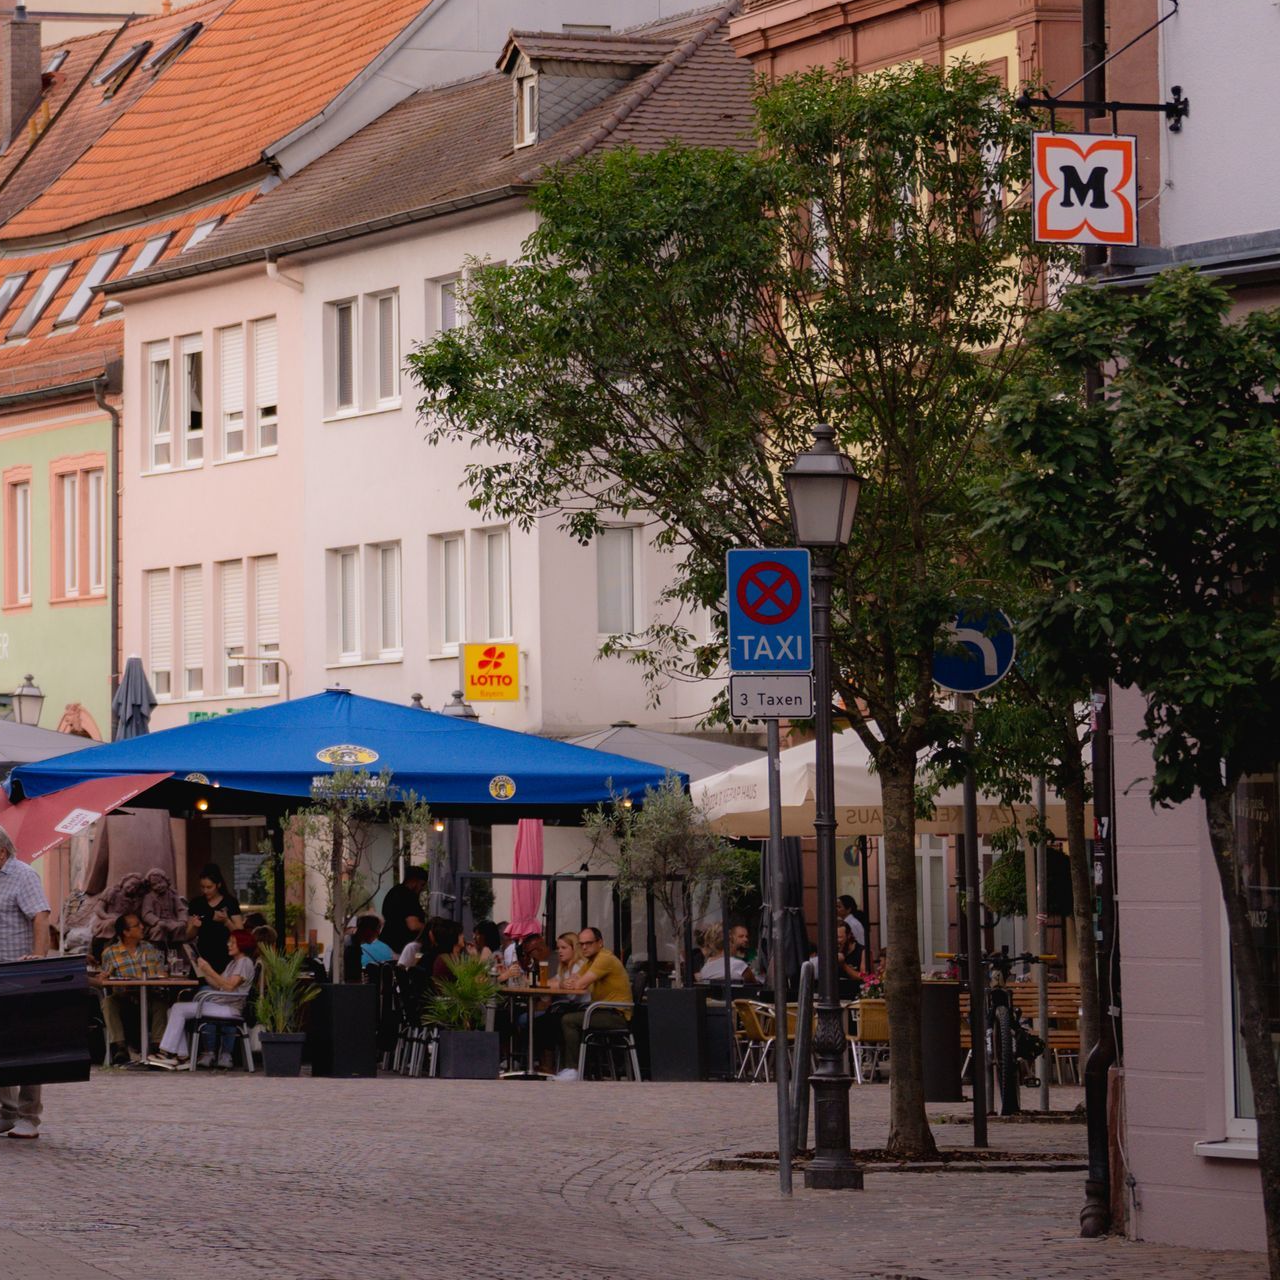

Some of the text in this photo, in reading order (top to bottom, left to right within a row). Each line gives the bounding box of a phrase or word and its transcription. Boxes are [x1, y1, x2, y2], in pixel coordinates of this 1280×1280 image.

[1058, 164, 1110, 210] M
[736, 635, 803, 660] TAXI
[471, 674, 512, 686] LOTTO
[740, 692, 803, 706] 3 Taxen
